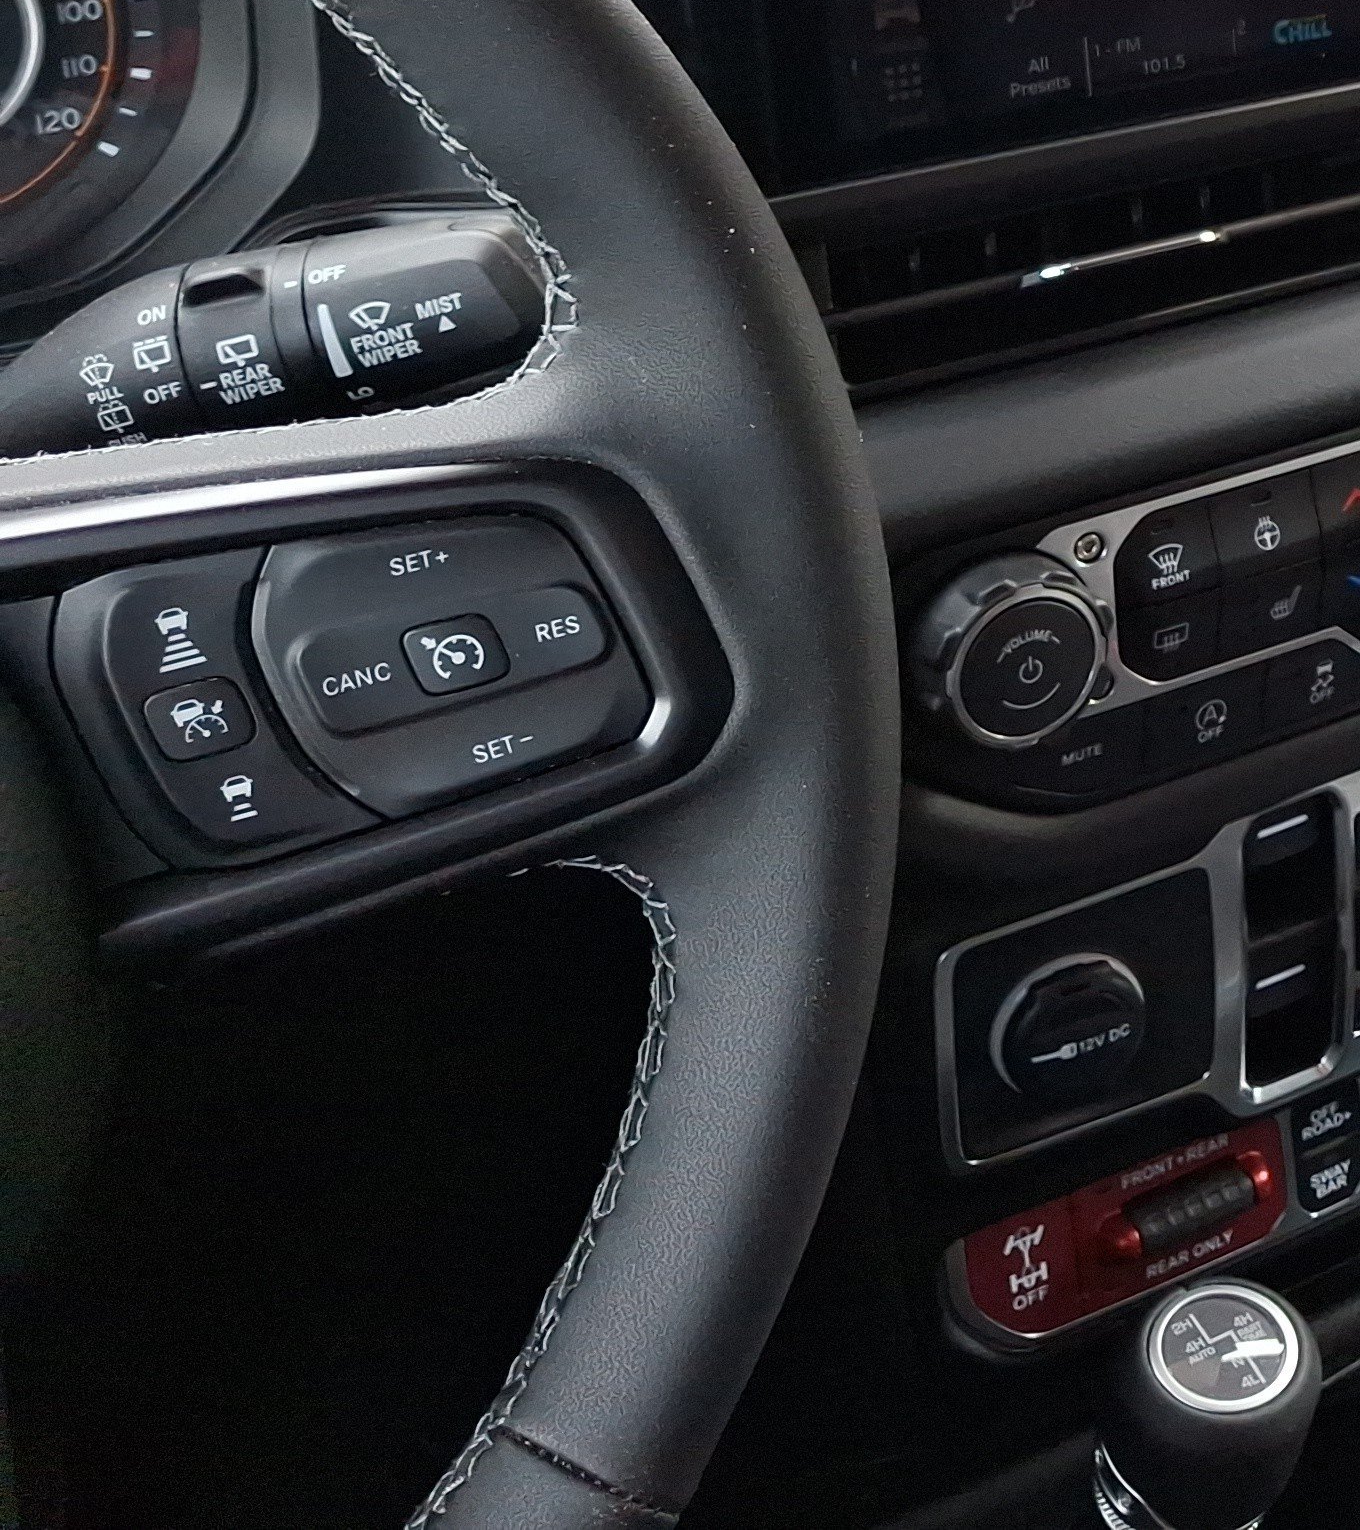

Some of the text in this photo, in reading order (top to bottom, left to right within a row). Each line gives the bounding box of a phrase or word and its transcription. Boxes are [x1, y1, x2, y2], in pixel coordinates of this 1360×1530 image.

[62, 54, 97, 79] 110
[1028, 55, 1050, 73] All
[1142, 54, 1186, 75] 101.5
[1009, 74, 1072, 98] Presets
[36, 107, 82, 135] 120
[308, 265, 346, 285] OFF
[137, 304, 167, 326] ON
[415, 293, 462, 319] MIST
[350, 323, 414, 351] FRONT
[357, 338, 422, 368] WIPER
[219, 363, 271, 388] REAR
[86, 386, 125, 405] PULL
[143, 381, 182, 405] OFF
[220, 376, 285, 405] WIPER
[1151, 569, 1191, 590] FRONT
[535, 615, 581, 643] RES
[1003, 628, 1053, 654] VOLUME
[322, 662, 391, 697] CANC
[1309, 684, 1336, 703] OFF
[1198, 725, 1225, 742] OFF
[1061, 744, 1103, 767] MUTE
[1079, 1022, 1132, 1053] 12V DC
[1145, 1228, 1234, 1280] REAR ONLY
[1012, 1286, 1049, 1311] OFF
[1170, 1318, 1193, 1337] 2H
[1233, 1312, 1254, 1328] 4H
[1185, 1337, 1205, 1355] 4H
[1188, 1346, 1216, 1365] AUTO
[1241, 1373, 1260, 1389] 4L
